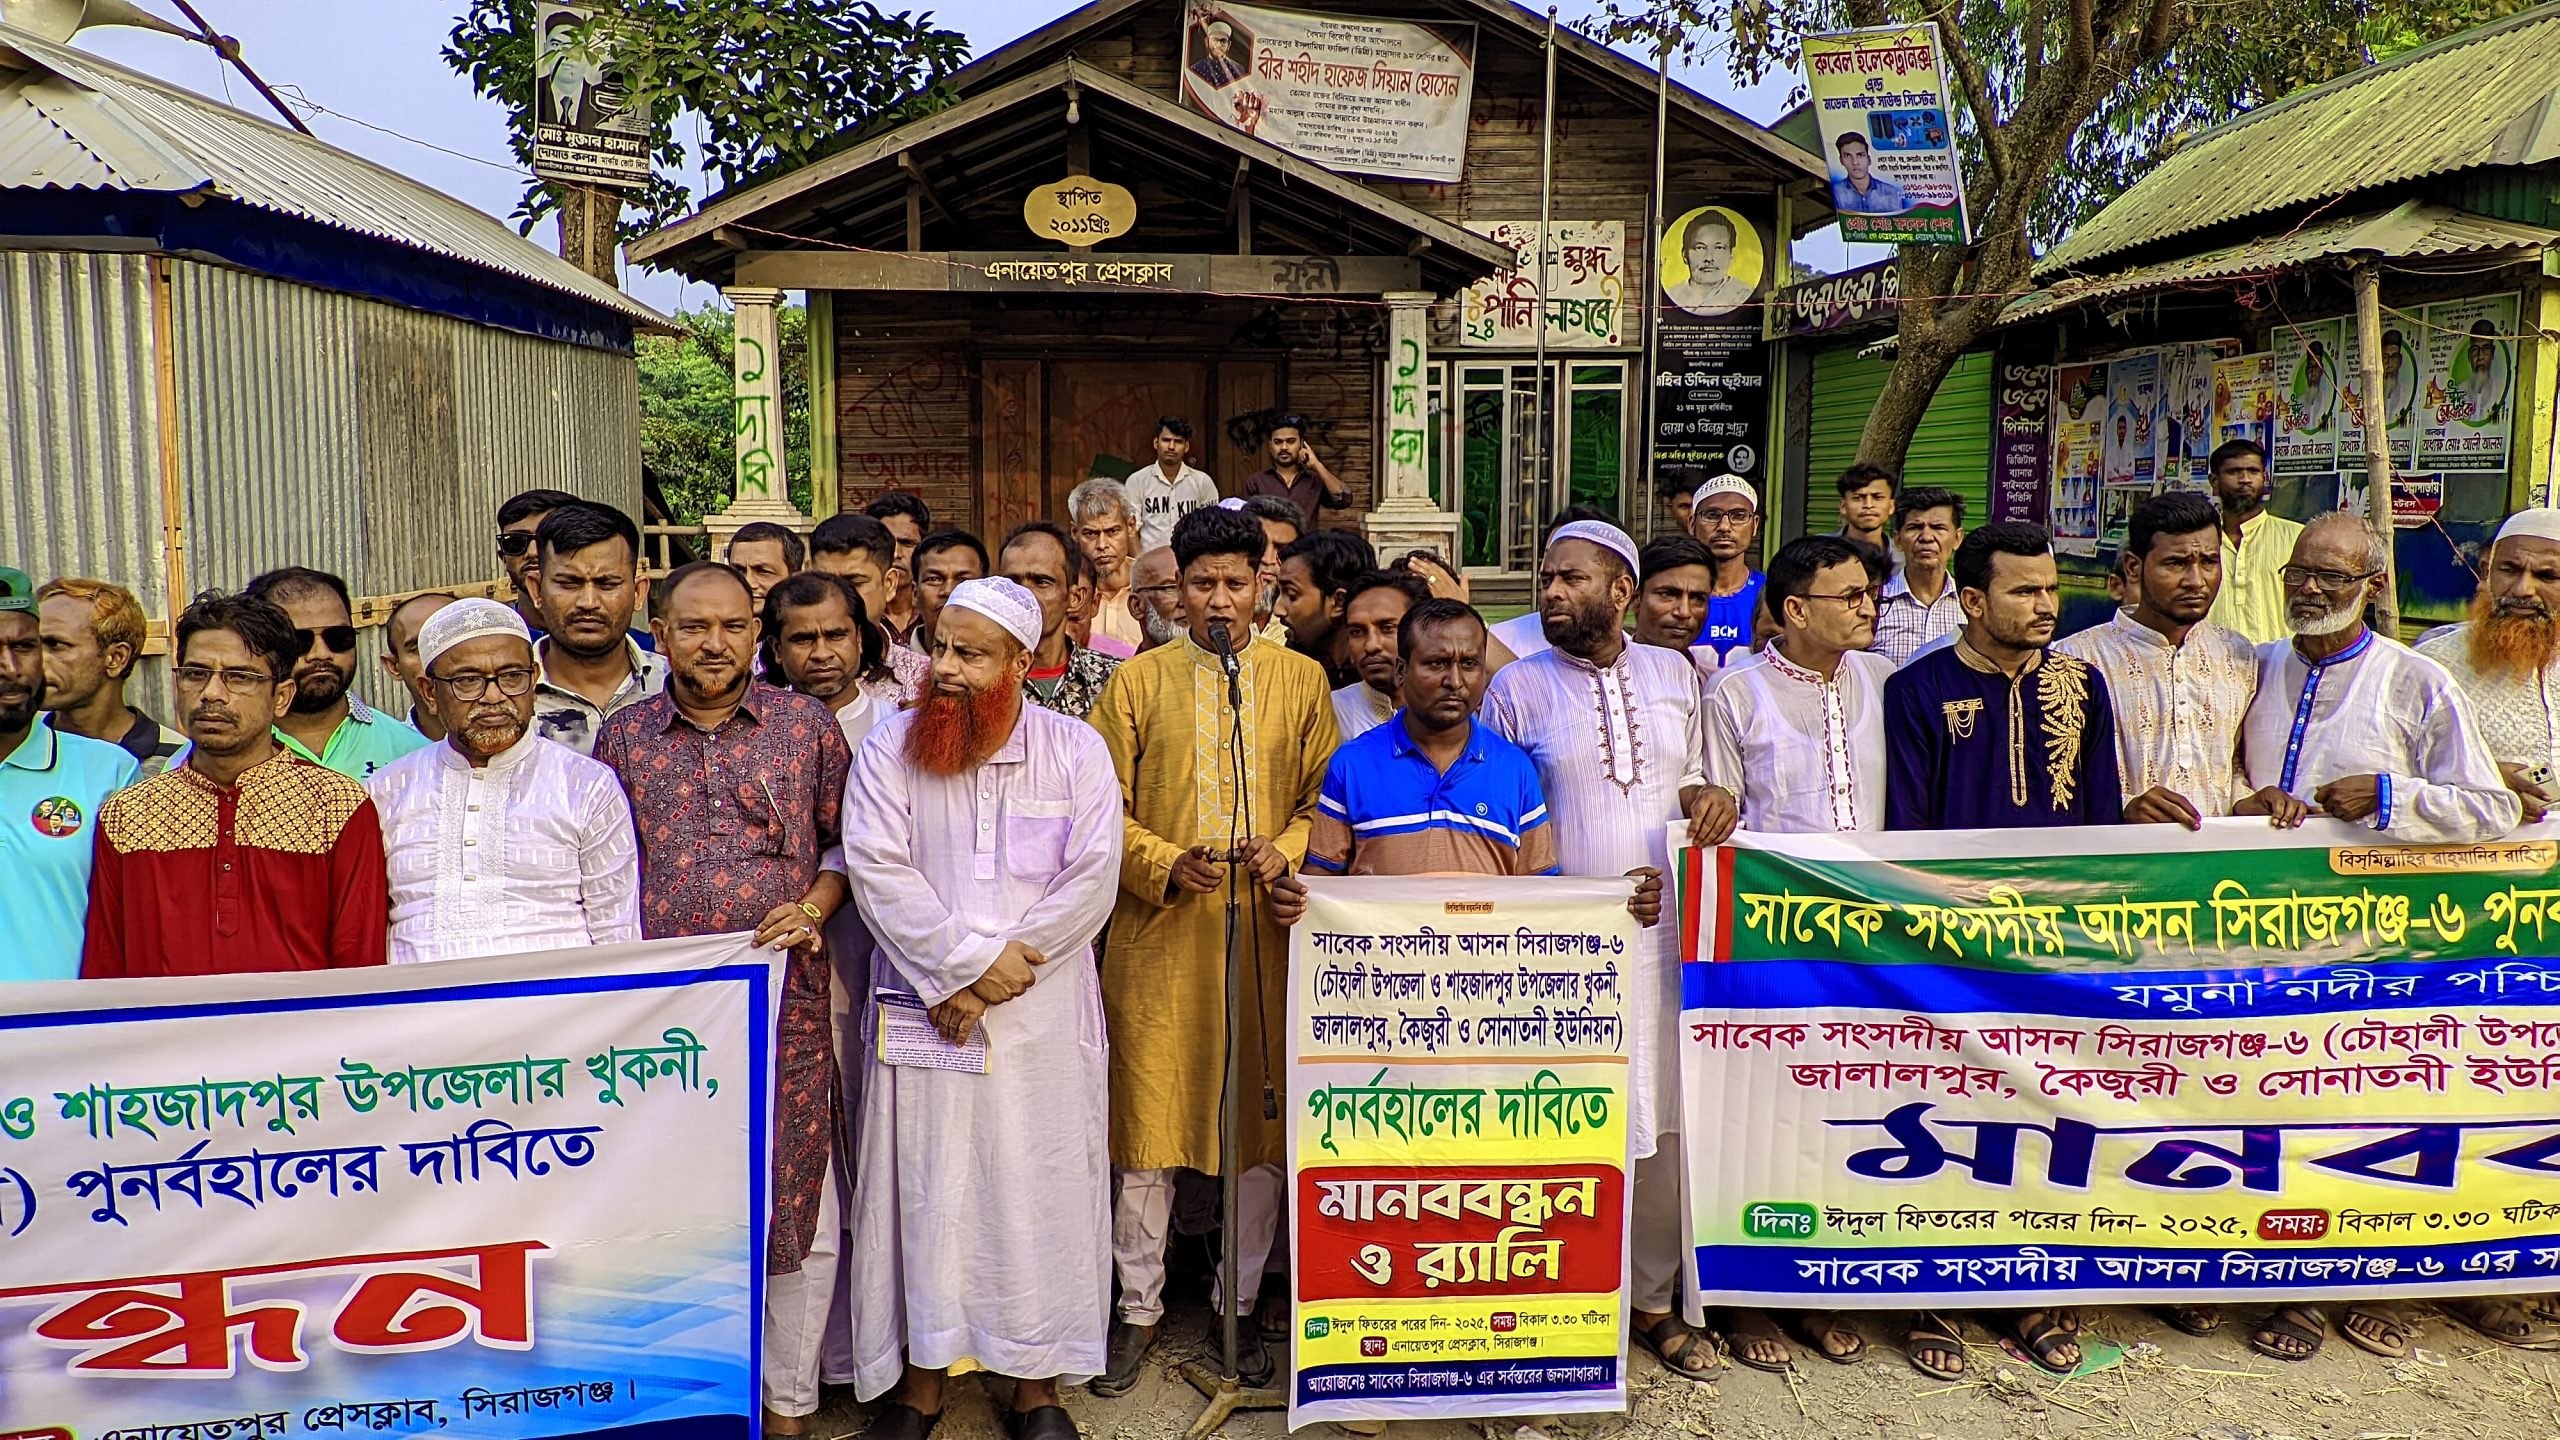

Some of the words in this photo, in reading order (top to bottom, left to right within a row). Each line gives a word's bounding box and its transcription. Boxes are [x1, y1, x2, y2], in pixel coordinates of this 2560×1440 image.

[1258, 48, 1284, 81] বীর
[1288, 52, 1321, 85] শহীদ
[1324, 64, 1369, 90] হাফেজ
[1372, 60, 1413, 94] সিয়াম
[1416, 72, 1460, 97] হোসেন
[1812, 51, 1852, 76] রুবেল
[1865, 77, 1883, 93] এন্ড
[1851, 93, 1875, 110] মাইক
[1876, 92, 1902, 107] সাউন্ড
[1902, 90, 1937, 107] সিস্টেম
[539, 127, 562, 142] মোঃ
[565, 131, 601, 148] মুক্তার
[604, 137, 639, 153] হাসান
[571, 152, 597, 164] কলম
[1056, 187, 1102, 208] স্থাপিত
[985, 259, 1089, 285] এনায়েতপুর
[1095, 262, 1174, 284] প্রেসক্লাব
[1484, 276, 1538, 330] পানি
[1545, 297, 1614, 338] লাগবে
[1467, 318, 1494, 341] ২৪
[1684, 372, 1720, 388] উদ্দিন
[1721, 372, 1762, 391] ভূইয়ার
[1660, 422, 1684, 436] দোয়া
[1686, 423, 1695, 433] ও
[1698, 418, 1724, 436] বিনম্র
[1725, 421, 1749, 437] শ্রদ্ধা
[2003, 415, 2046, 438] প্রিন্টার্স
[2011, 443, 2034, 453] এখানে
[2422, 438, 2444, 452] অধ্যক্ষ
[2445, 438, 2460, 452] মোঃ
[2463, 432, 2481, 451] আলী
[2482, 437, 2503, 451] আলম
[2006, 454, 2037, 465] ডিজিটাল
[2002, 480, 2039, 492] সাইনবোর্ড
[2009, 468, 2032, 478] ব্যানার
[2504, 845, 2547, 864] রাহিম
[1740, 888, 1892, 949] সাবেক
[1901, 885, 2066, 958] সংসদীয়
[2074, 893, 2200, 957] আসন
[2208, 879, 2466, 954] সিরাজগঞ্জ-৬
[1312, 931, 1374, 956] সাবেক
[1381, 927, 1451, 958] সংসদীয়
[1456, 931, 1510, 956] আসন
[1516, 927, 1624, 956] সিরাজগঞ্জ-৬
[1314, 961, 1368, 1006] (চৌহালী
[1371, 963, 1426, 1001] উপজেলা
[1431, 975, 1441, 995] ও
[1446, 969, 1514, 1007] শাহজাদপুর
[1518, 962, 1580, 1002] উপজেলার
[1584, 961, 1622, 1006] খুকনী,
[2111, 979, 2261, 1014] যমুনা
[2279, 968, 2426, 1003] নদীর
[1312, 1011, 1393, 1053] জালালপুর,
[1399, 1006, 1452, 1055] কৈজুরী
[1458, 1020, 1470, 1043] ও
[1478, 1007, 1549, 1048] সোনাতনী
[1553, 1006, 1624, 1053] ইউনিয়ন)
[1690, 1020, 1811, 1051] সাবেক
[1819, 1016, 1970, 1053] সংসদীয়
[1979, 1025, 2086, 1057] আসন
[2095, 1024, 2309, 1060] সিরাজগঞ্জ-৬
[2323, 1013, 2467, 1061] (চৌহালী
[0, 1097, 35, 1140] ও
[53, 1073, 326, 1142] শাহজাদপুর
[335, 1053, 571, 1114] উপজেলার
[586, 1026, 719, 1109] খুকনী,
[1786, 1060, 2017, 1099] জালালপুর,
[2034, 1061, 2188, 1104] কৈজুরী
[2203, 1073, 2239, 1096] ও
[2258, 1055, 2452, 1098] সোনাতনী
[1495, 1069, 1615, 1141] দাবিতে
[66, 1138, 388, 1227] পুনর্বহালের
[400, 1118, 605, 1185] দাবিতে
[1314, 1176, 1602, 1227] মানববন্ধন
[1750, 1204, 1811, 1235] দিনঃ
[1823, 1204, 1889, 1238] ঈদুল
[1895, 1204, 1999, 1234] ফিতরের
[2008, 1208, 2082, 1233] পরের
[2090, 1206, 2147, 1235] দিন-
[2160, 1213, 2248, 1239] ২০২৫,
[2337, 1208, 2417, 1234] বিকাল
[2423, 1212, 2490, 1231] ৩.৩০
[1350, 1243, 1393, 1286] ও
[1795, 1256, 1925, 1287] সাবেক
[1932, 1246, 2084, 1288] সংসদীয়
[2095, 1256, 2208, 1283] আসন
[2218, 1251, 2445, 1283] সিরাজগঞ্জ-৬
[2461, 1249, 2525, 1275] এর
[1332, 1319, 1355, 1336] ঈদুল
[1359, 1315, 1398, 1332] ফিতরের
[1401, 1318, 1427, 1331] পরের
[1430, 1314, 1452, 1331] দিন-
[1455, 1317, 1489, 1332] ২০২৫,
[1519, 1312, 1548, 1327] বিকাল
[1550, 1316, 1578, 1326] ৩.৩০
[1582, 1311, 1611, 1326] ঘটিকা
[1392, 1339, 1445, 1355] এনায়েতপুর
[1448, 1337, 1490, 1354] প্রেসক্লাব,
[1308, 1373, 1364, 1393] আয়োজনেঃ
[1369, 1371, 1404, 1390] সাবেক
[1408, 1368, 1473, 1389] সিরাজগঞ্জ-৬
[1477, 1370, 1494, 1385] এর
[1497, 1363, 1543, 1386] সর্বস্তরের
[304, 1399, 447, 1431] প্রেসক্লাব,
